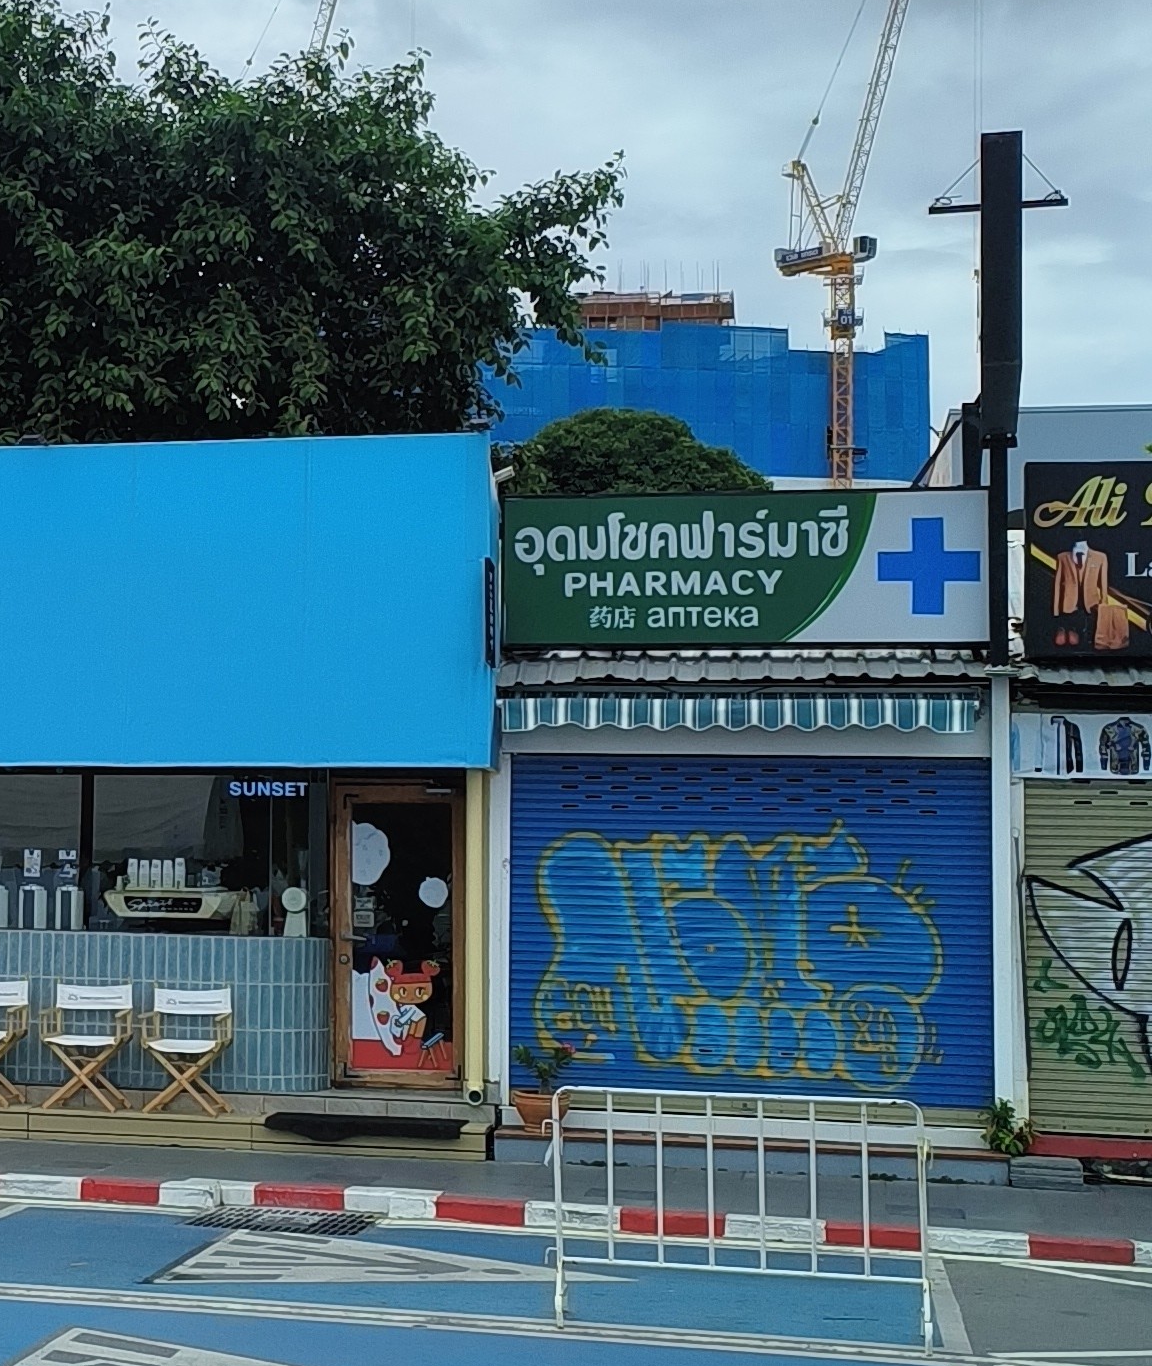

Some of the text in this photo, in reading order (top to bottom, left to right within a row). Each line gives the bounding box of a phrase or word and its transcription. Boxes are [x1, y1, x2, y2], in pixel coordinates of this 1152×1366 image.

[840, 315, 852, 325] 01
[1033, 475, 1128, 528] Ali
[564, 570, 783, 598] PHARMACY
[589, 606, 759, 629] 药店 аптека
[229, 781, 308, 797] SUNSET
